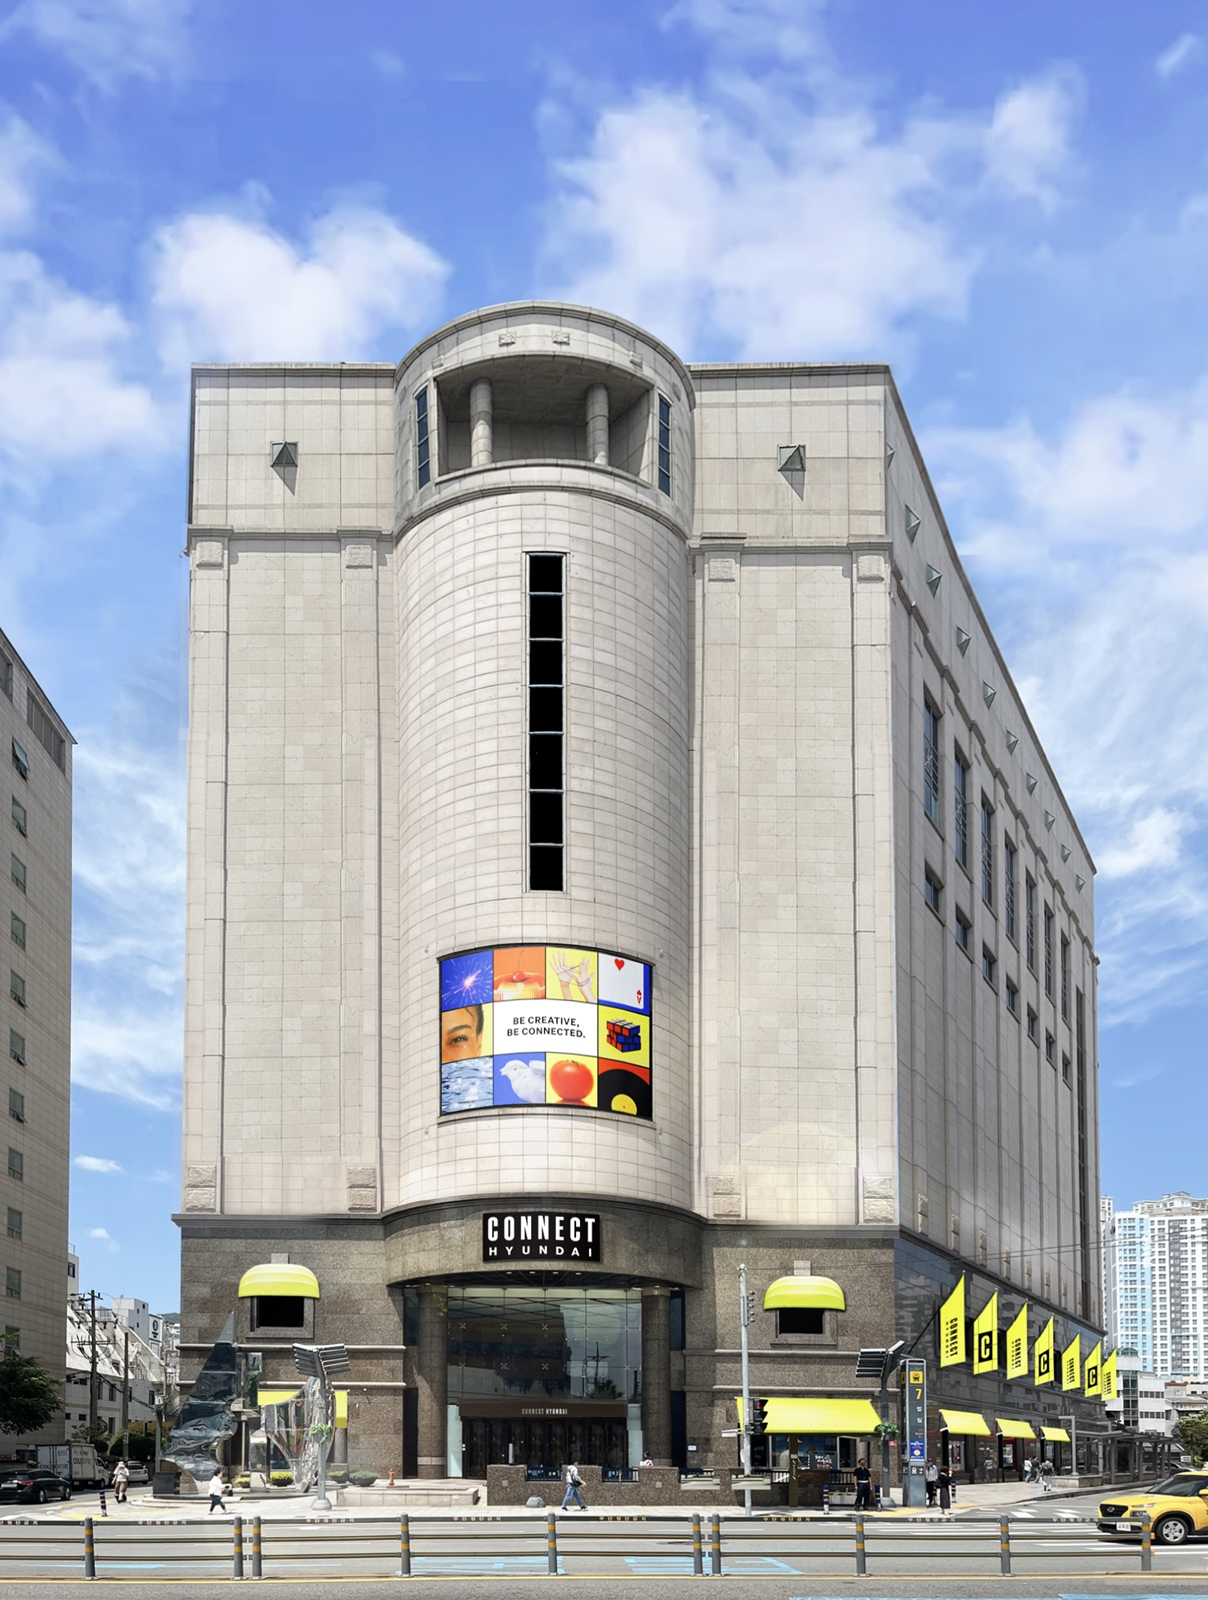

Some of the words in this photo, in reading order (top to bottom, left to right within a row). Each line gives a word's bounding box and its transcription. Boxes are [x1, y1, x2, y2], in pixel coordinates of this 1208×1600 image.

[513, 1016, 526, 1025] BE
[528, 1016, 580, 1028] CREATIVE,
[507, 1028, 520, 1037] BE
[521, 1027, 586, 1039] CONNECTED.
[487, 1215, 596, 1243] CONNECT
[489, 1245, 592, 1257] HYUNDAI
[950, 1317, 958, 1357] CONNECT
[981, 1334, 990, 1359] C
[1040, 1353, 1048, 1373] C
[1089, 1368, 1096, 1386] C
[915, 1388, 923, 1400] 7
